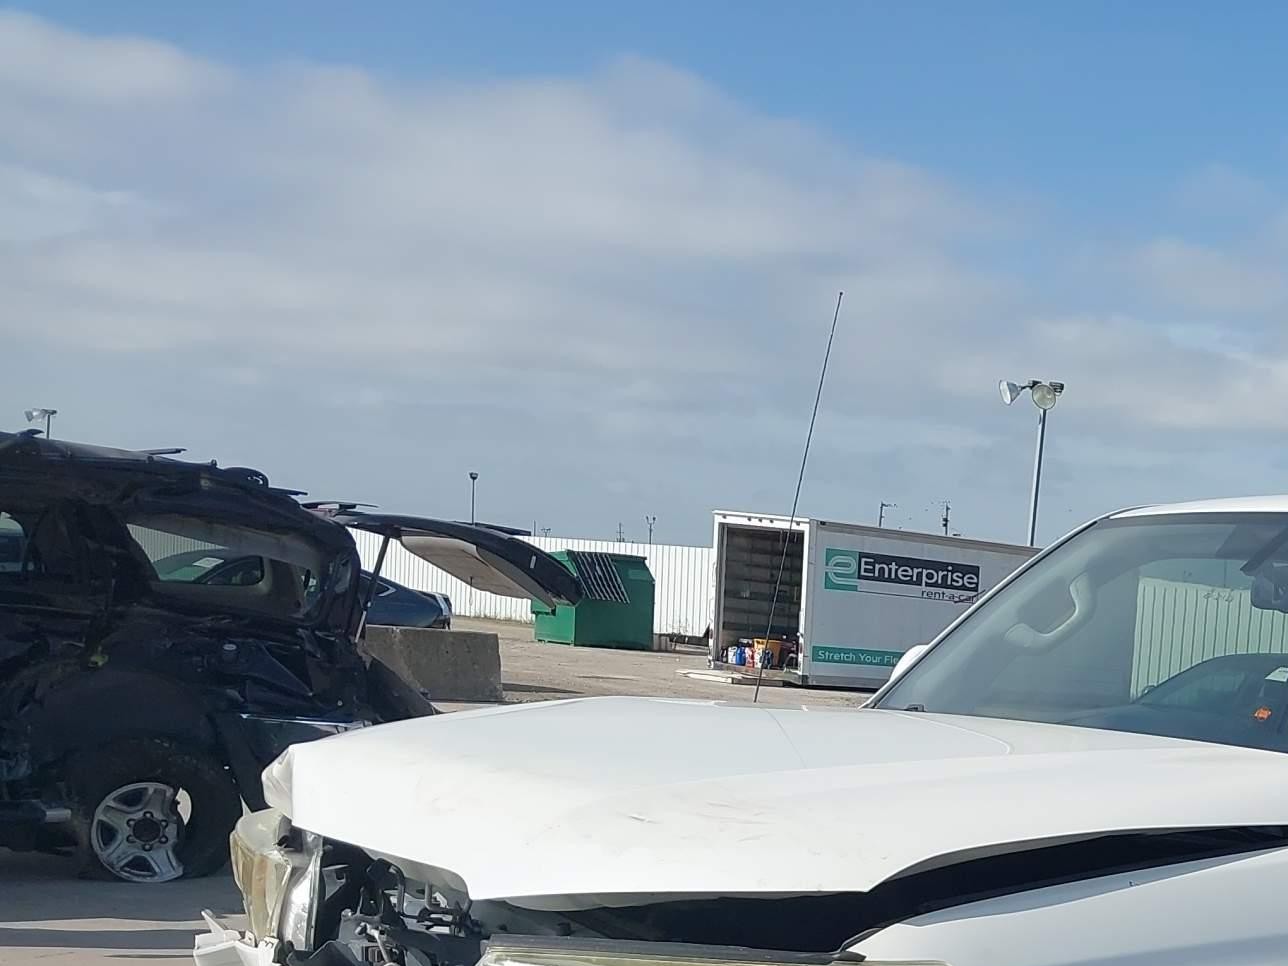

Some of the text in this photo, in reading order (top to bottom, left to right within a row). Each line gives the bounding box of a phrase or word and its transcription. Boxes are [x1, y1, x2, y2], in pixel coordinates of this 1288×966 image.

[860, 557, 978, 588] Enterprise
[817, 650, 856, 662] Stretch
[859, 653, 882, 664] Your
